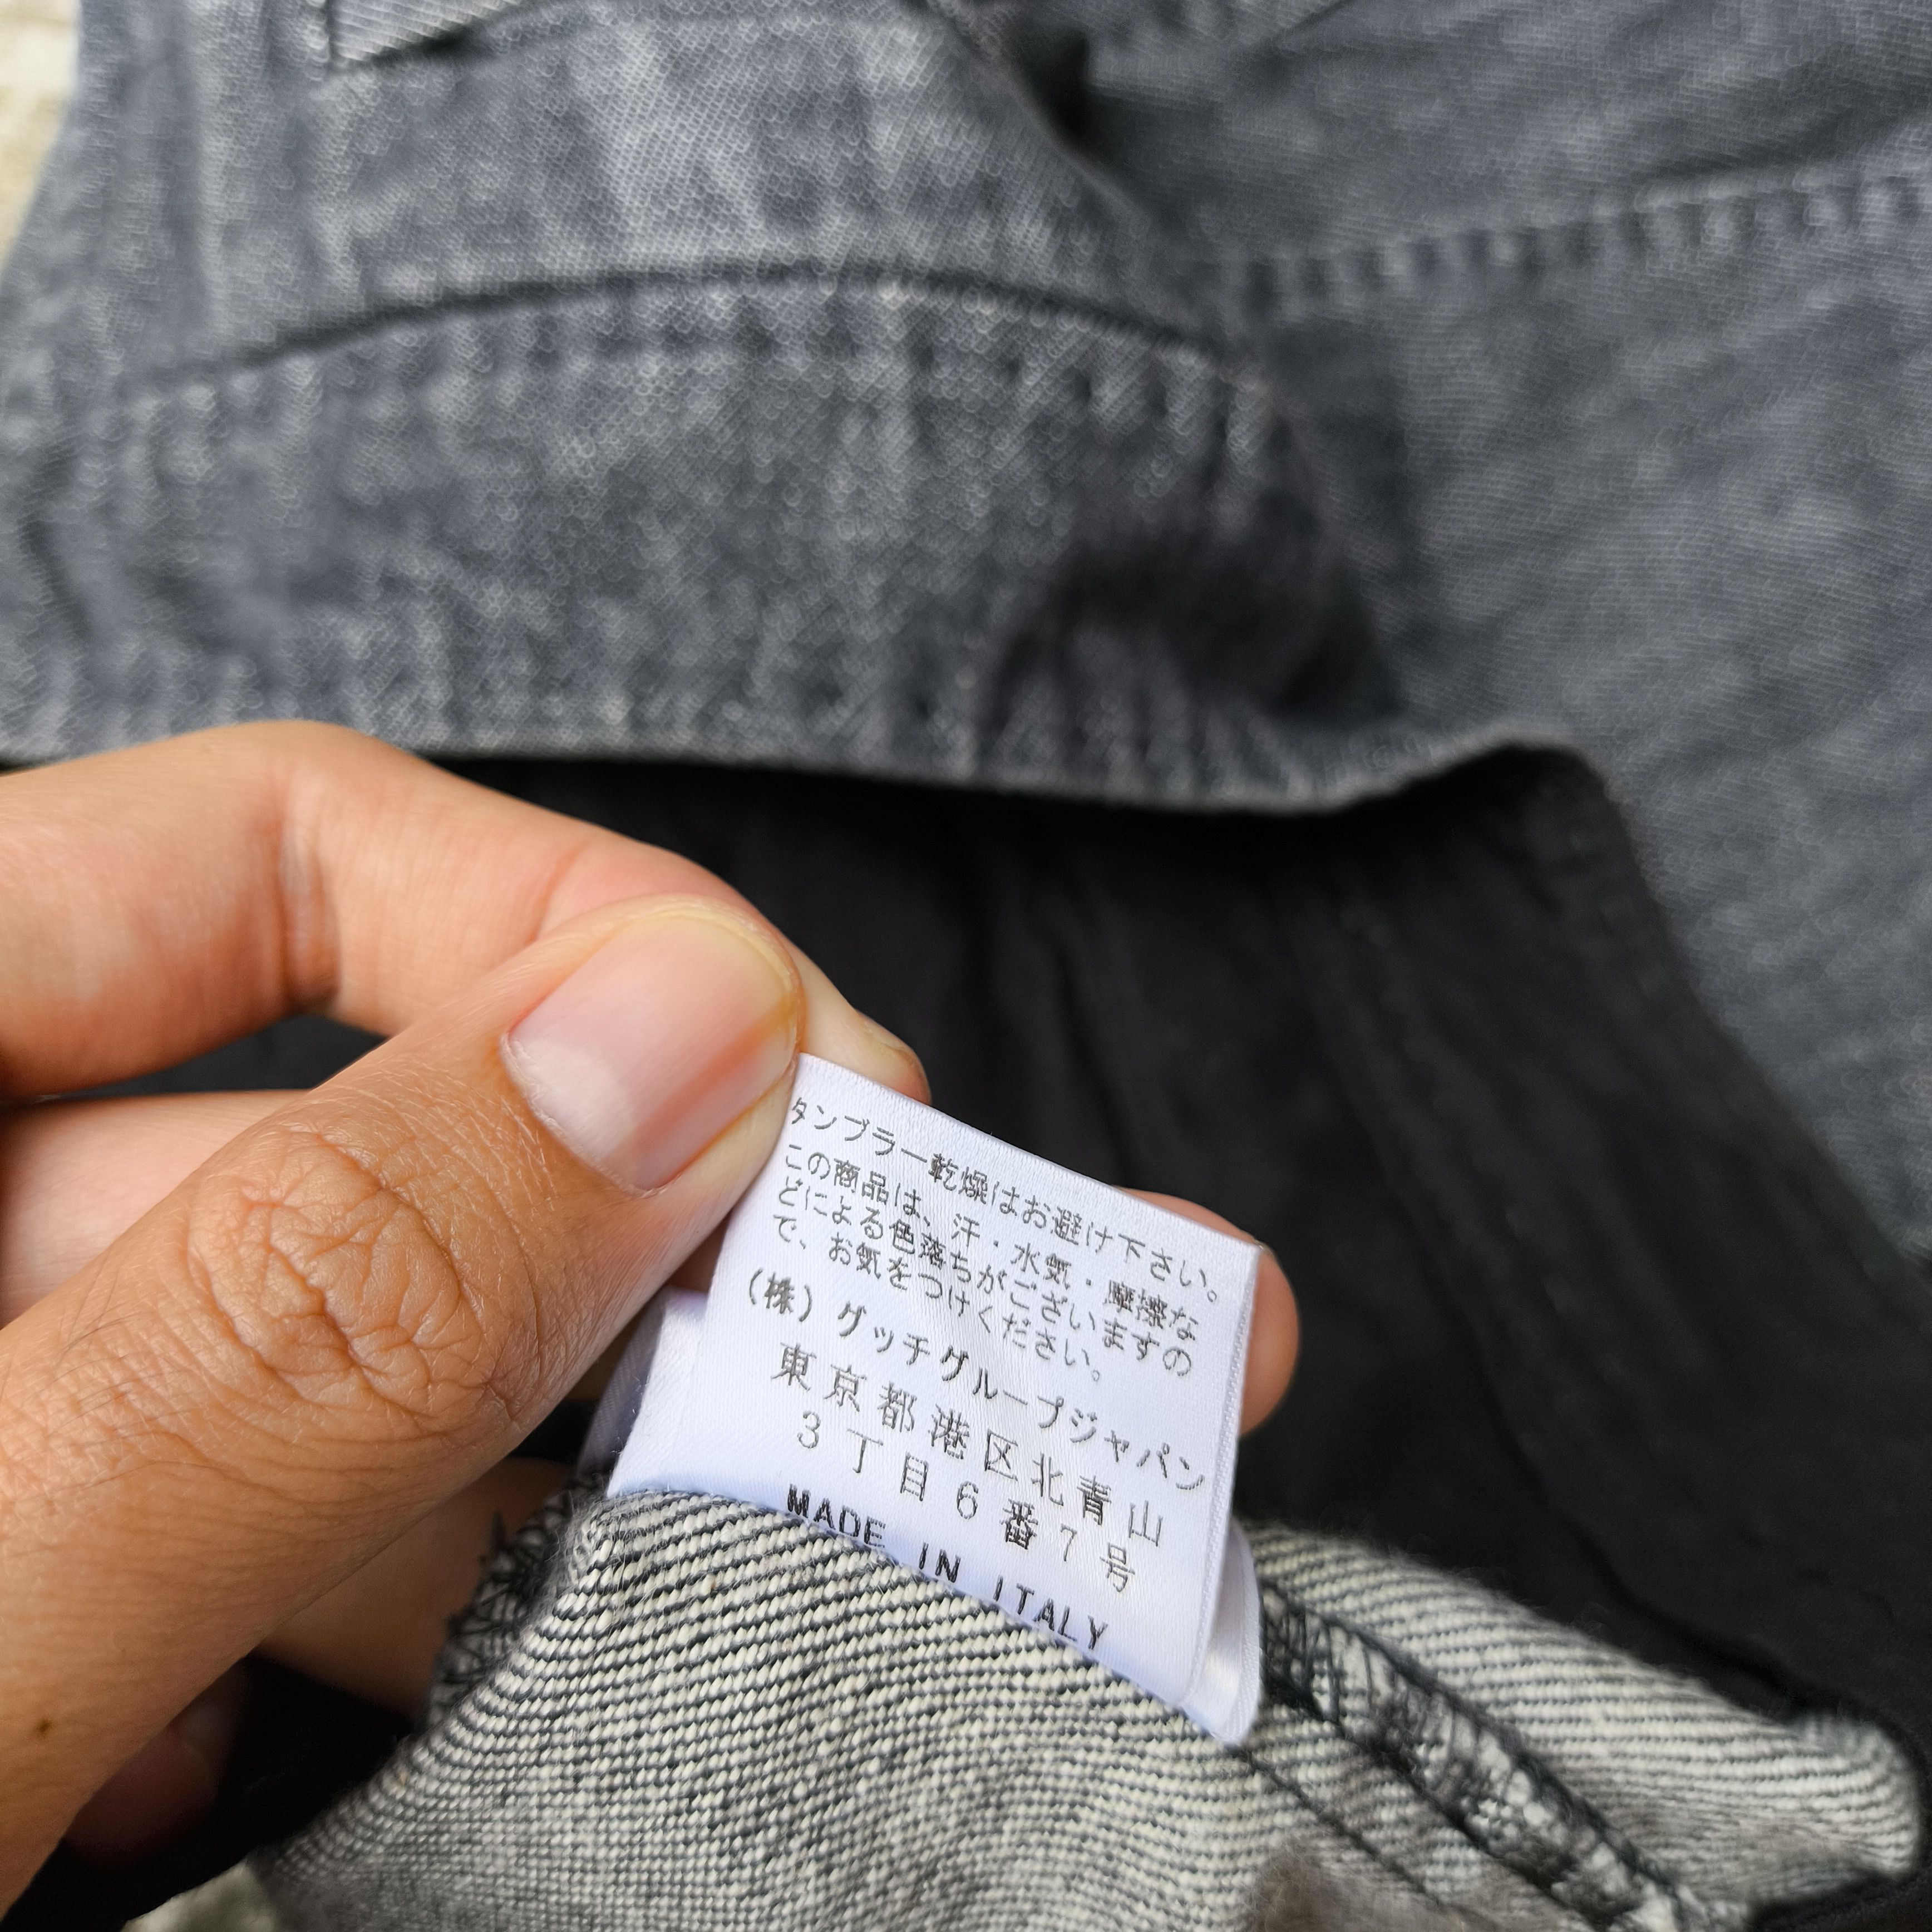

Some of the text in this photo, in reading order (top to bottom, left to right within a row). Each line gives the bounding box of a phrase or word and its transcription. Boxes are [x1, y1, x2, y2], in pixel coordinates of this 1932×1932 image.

[770, 1342, 1164, 1547] 東京都港区北青山
[787, 1483, 1109, 1650] MADE IN ITALY
